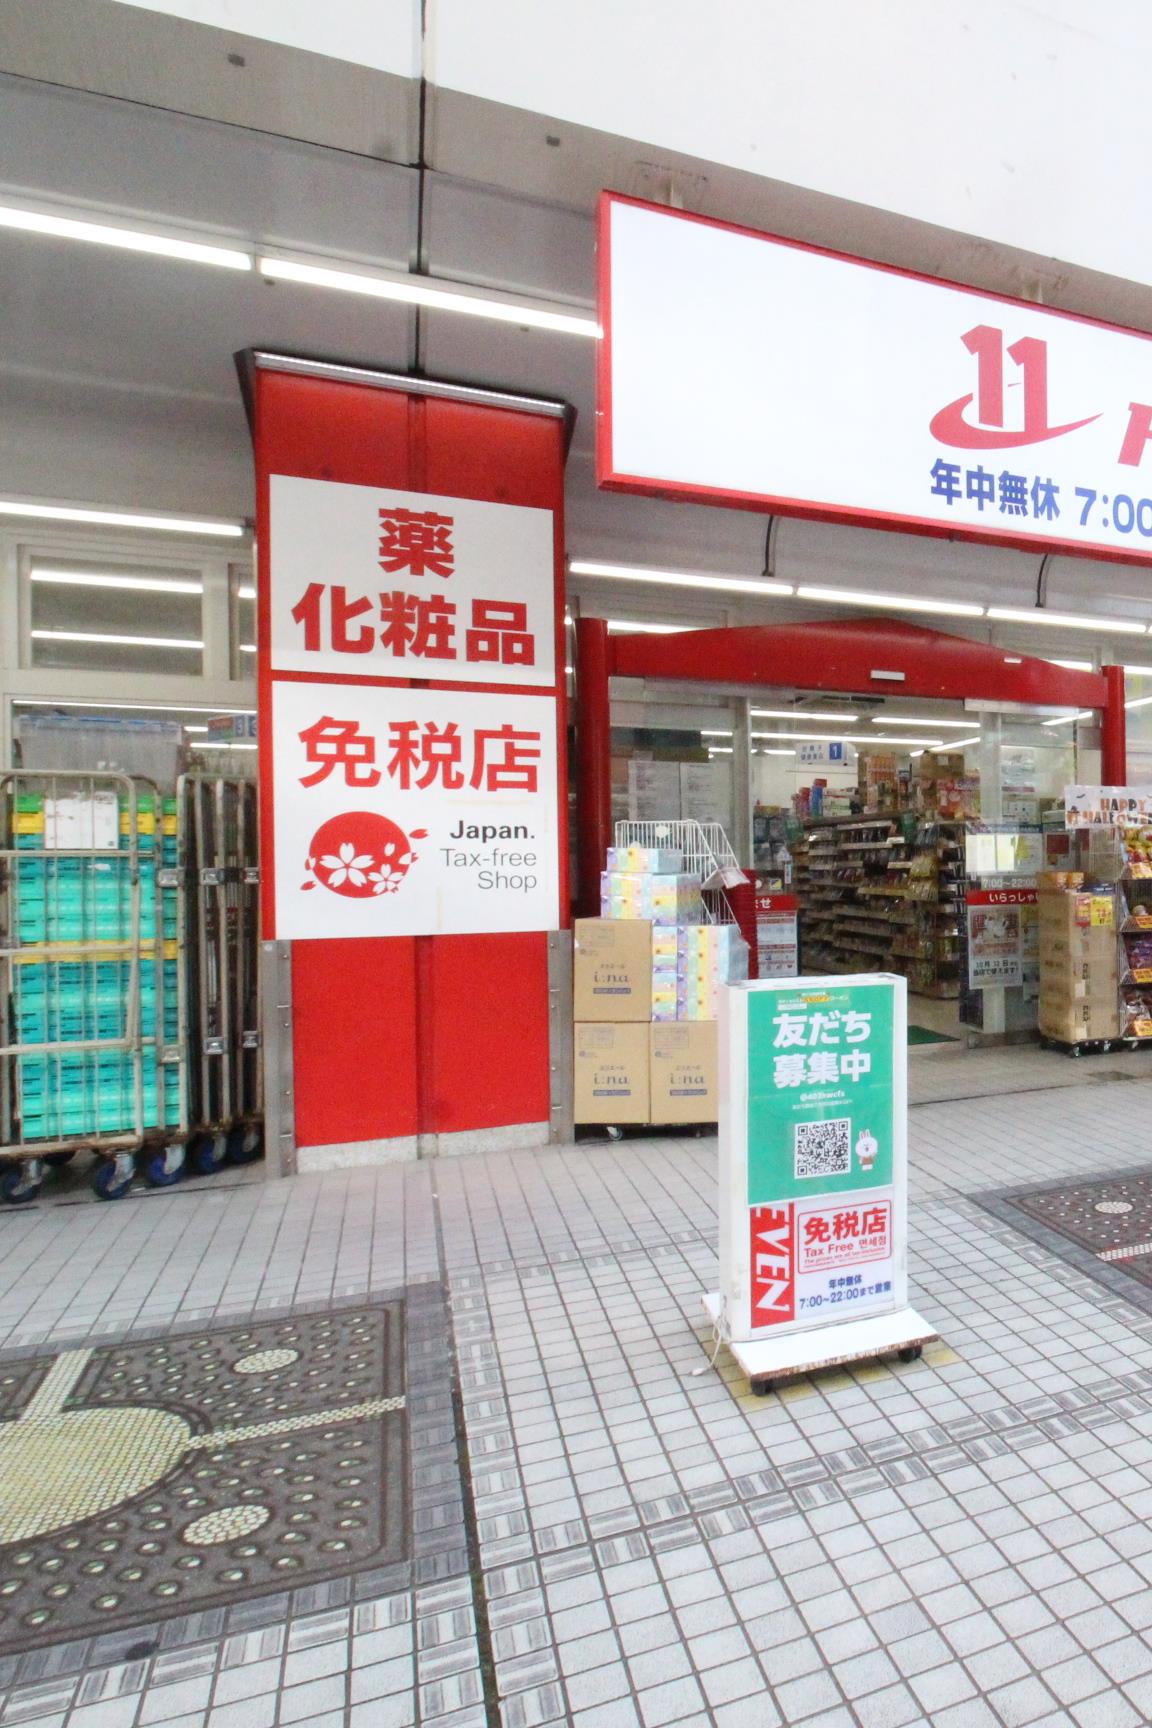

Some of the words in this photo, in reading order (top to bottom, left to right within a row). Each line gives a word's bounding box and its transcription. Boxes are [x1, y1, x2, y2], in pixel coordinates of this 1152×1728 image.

[929, 457, 1061, 521] 年中無休
[378, 507, 455, 579] 薬
[290, 582, 535, 666] 化粧品
[298, 715, 541, 793] 免税店
[1100, 798, 1146, 812] HAPPY
[449, 819, 535, 843] Japan.
[440, 848, 537, 868] Tax-free
[477, 870, 538, 893] Shop
[772, 1010, 872, 1048] 友だち
[772, 1049, 872, 1088] 募集中
[804, 1207, 887, 1246] 免税店
[804, 1247, 824, 1258] Tax
[828, 1242, 854, 1254] Free
[829, 1274, 862, 1289] 年中無休
